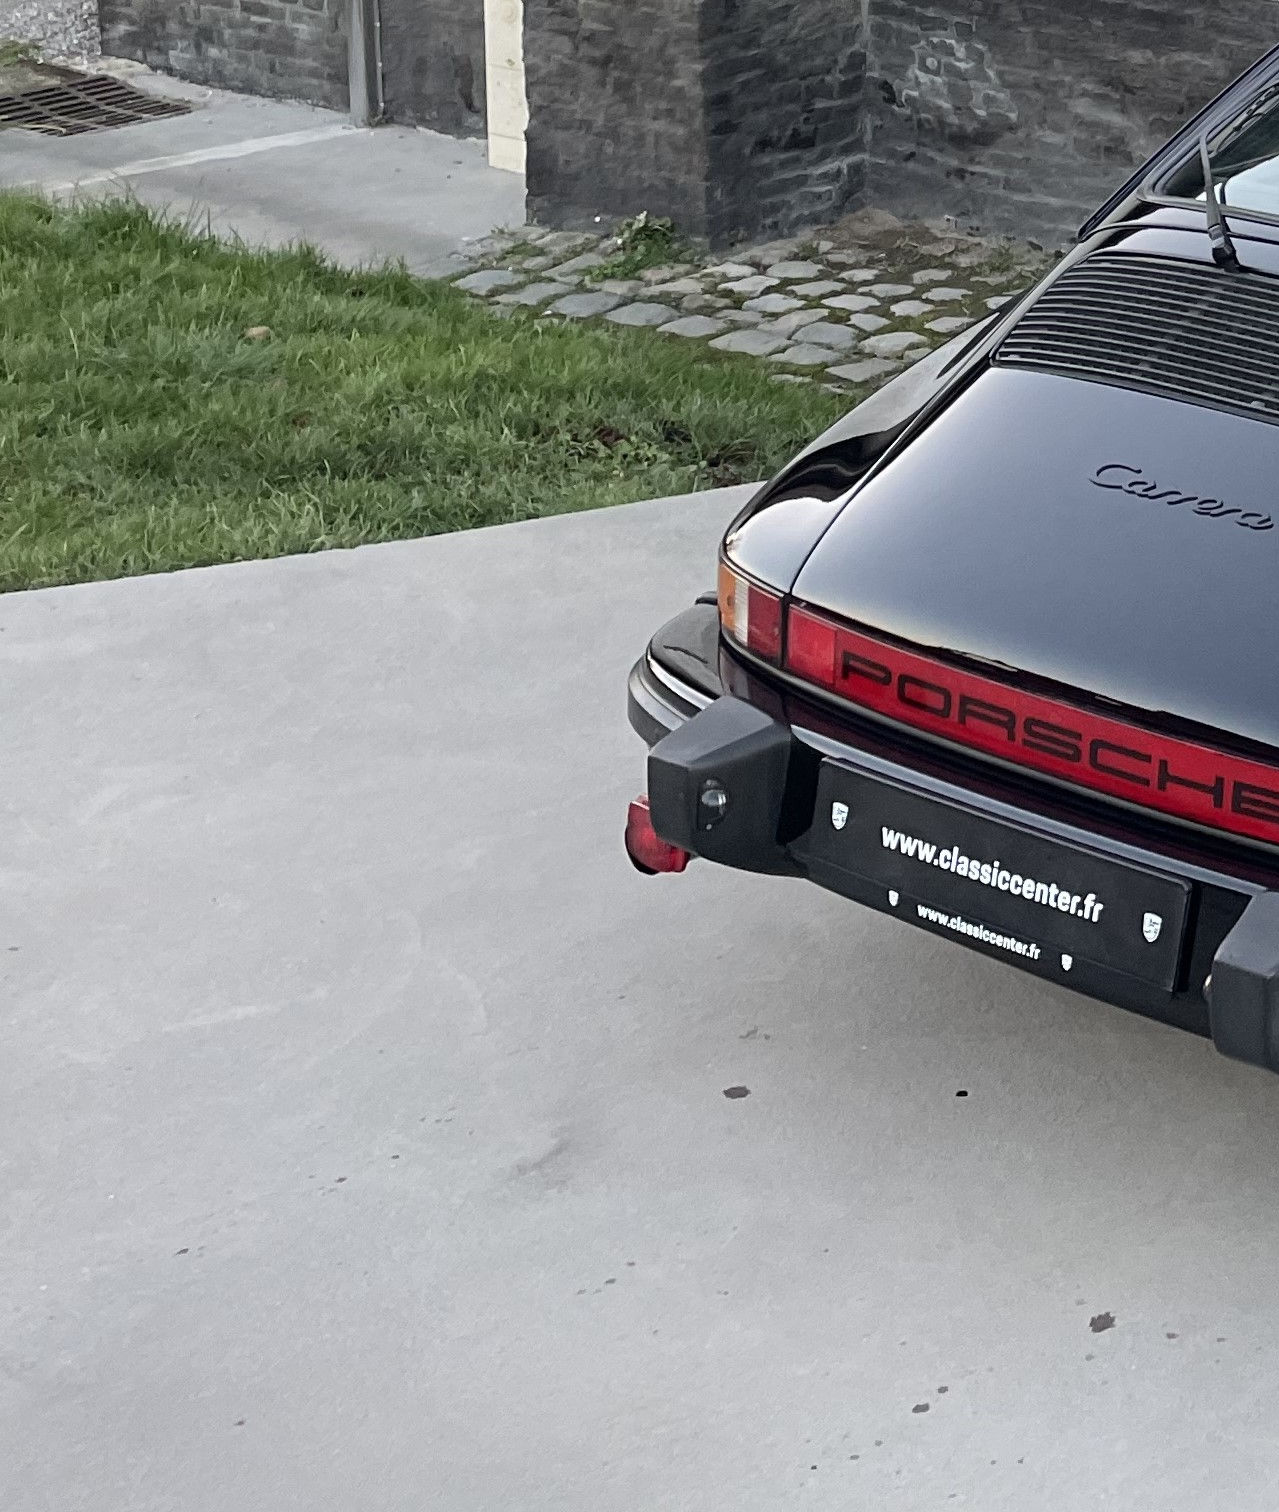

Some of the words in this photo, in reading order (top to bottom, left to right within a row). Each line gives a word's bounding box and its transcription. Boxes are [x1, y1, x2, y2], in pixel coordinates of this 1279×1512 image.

[1089, 464, 1274, 530] Carrera
[881, 826, 1104, 923] www.classiccenter.fr
[917, 904, 1041, 960] www.classiccenter.fr
